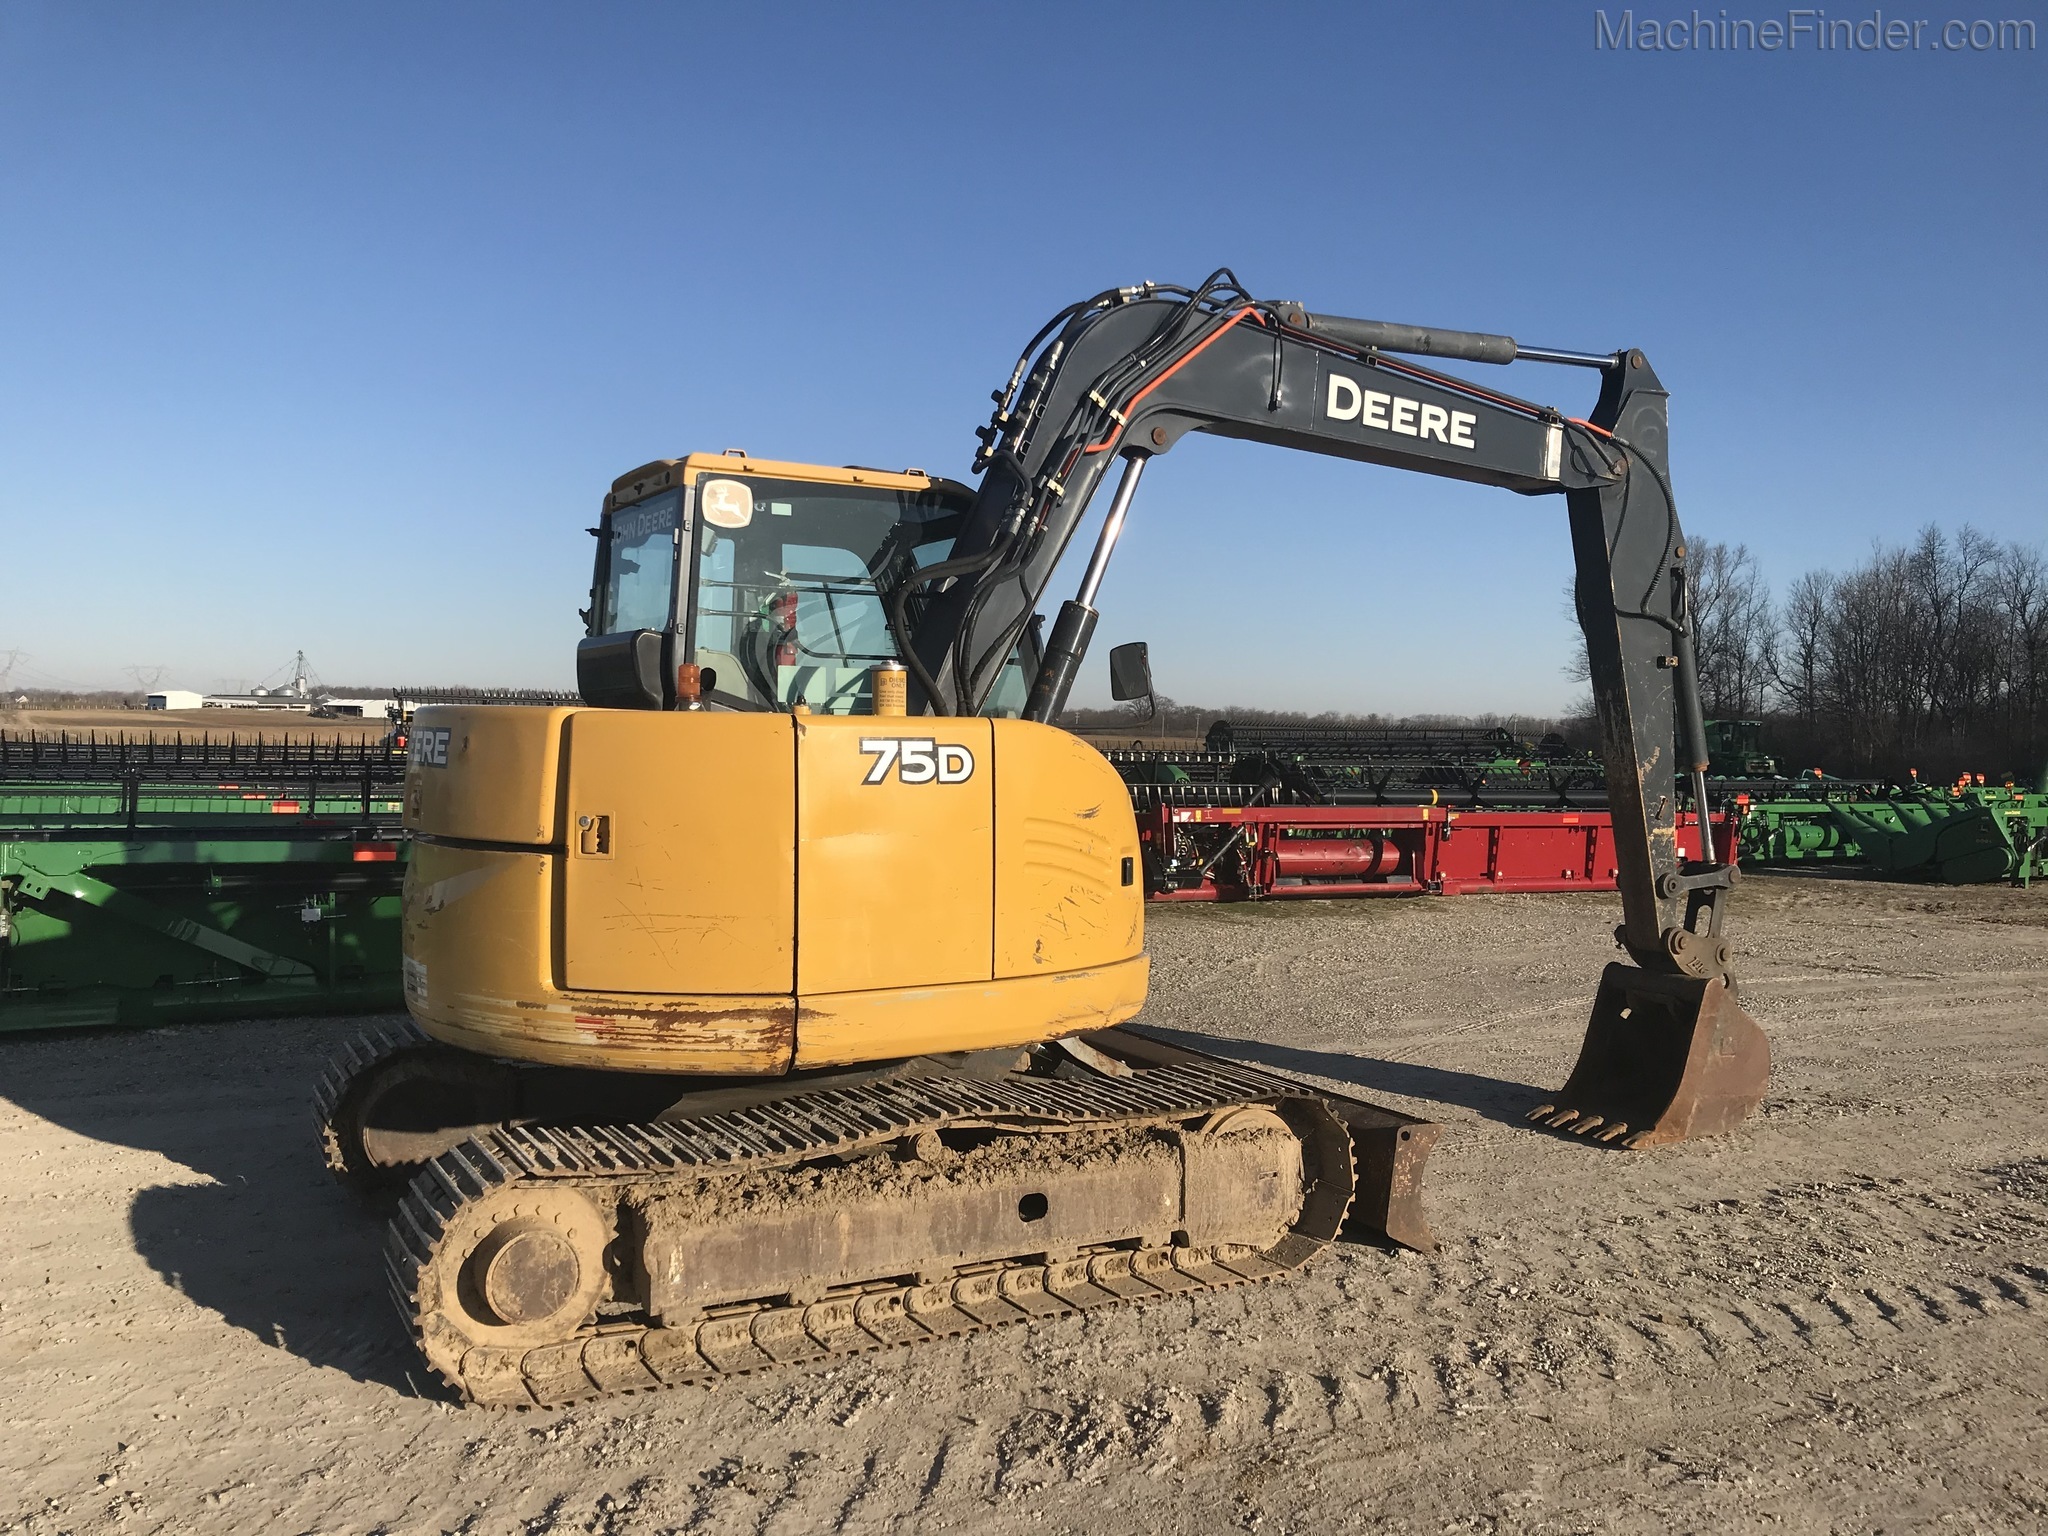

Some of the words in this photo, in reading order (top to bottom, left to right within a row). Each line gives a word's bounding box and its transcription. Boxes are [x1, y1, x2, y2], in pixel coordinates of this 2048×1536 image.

[1326, 373, 1477, 449] DEERE
[638, 507, 674, 537] DEERE
[861, 740, 973, 782] 75D
